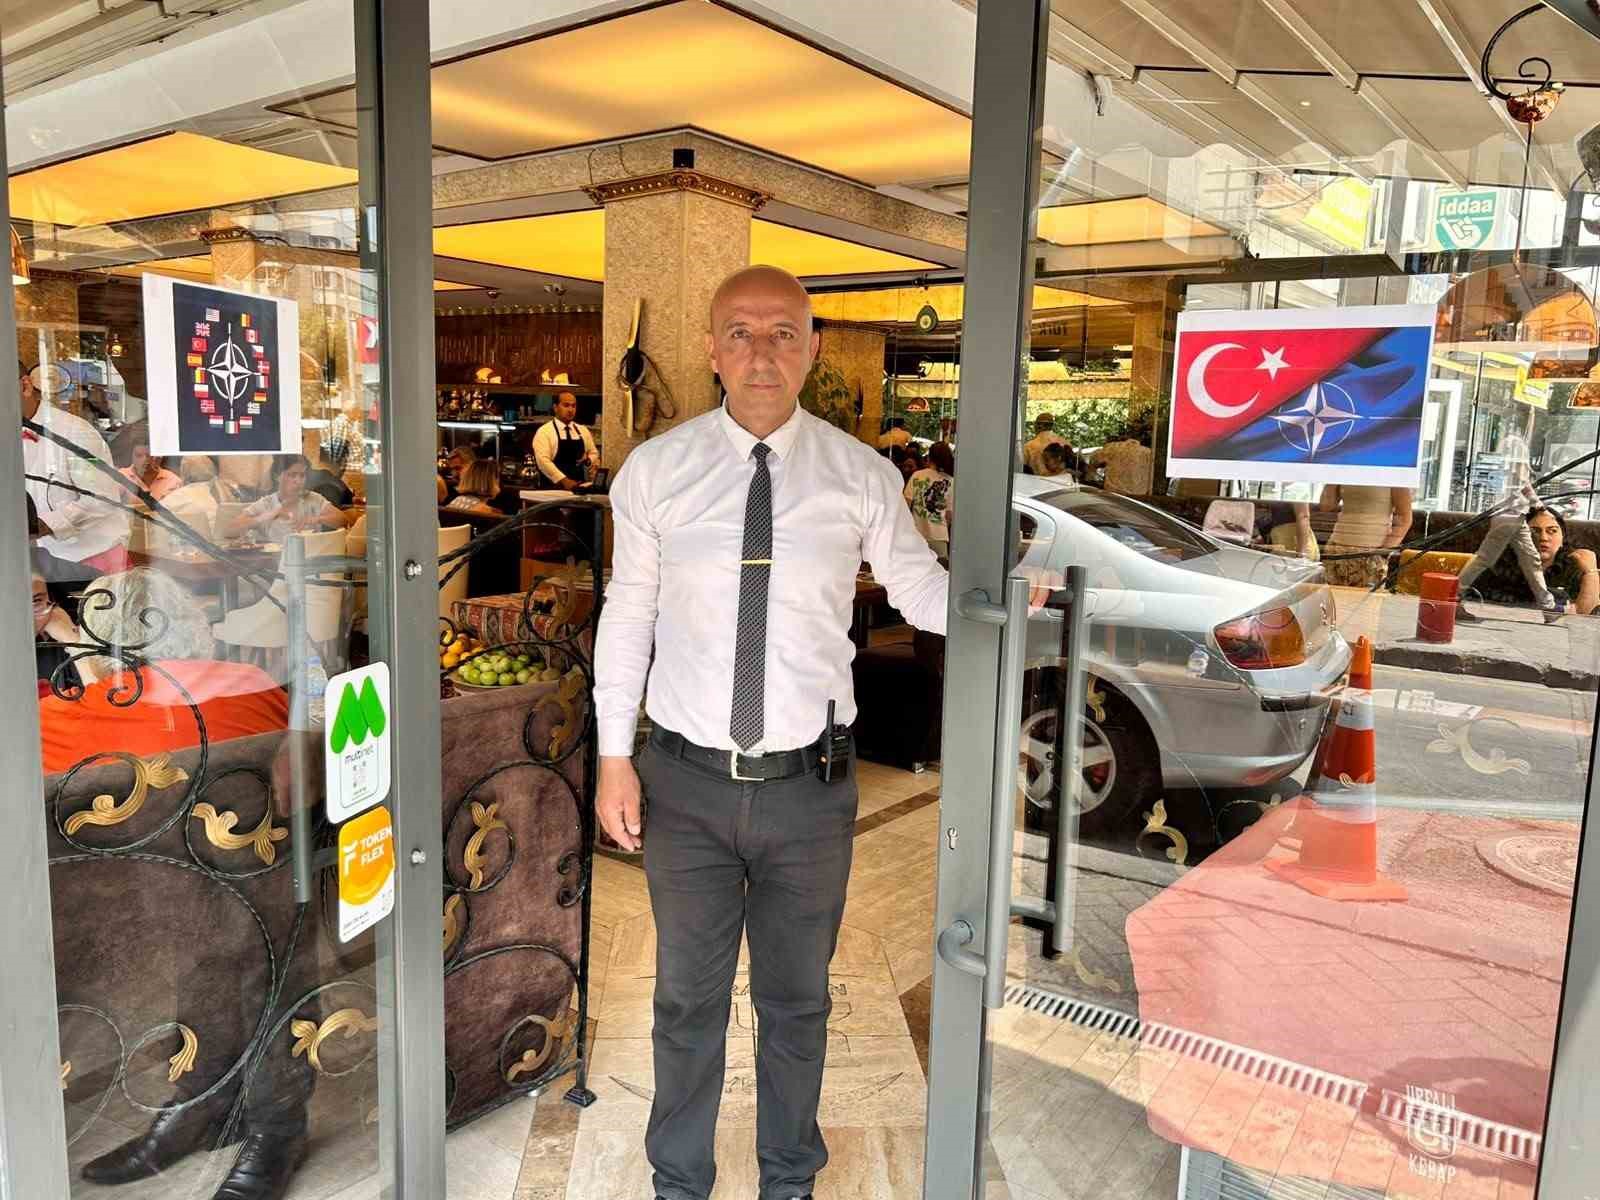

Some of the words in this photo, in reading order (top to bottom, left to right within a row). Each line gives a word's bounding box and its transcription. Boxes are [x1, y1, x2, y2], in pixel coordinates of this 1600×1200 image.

[1440, 197, 1493, 216] iddaa
[360, 826, 392, 850] TOKEN
[361, 845, 385, 866] FLEX
[1408, 1152, 1456, 1184] KEBAP
